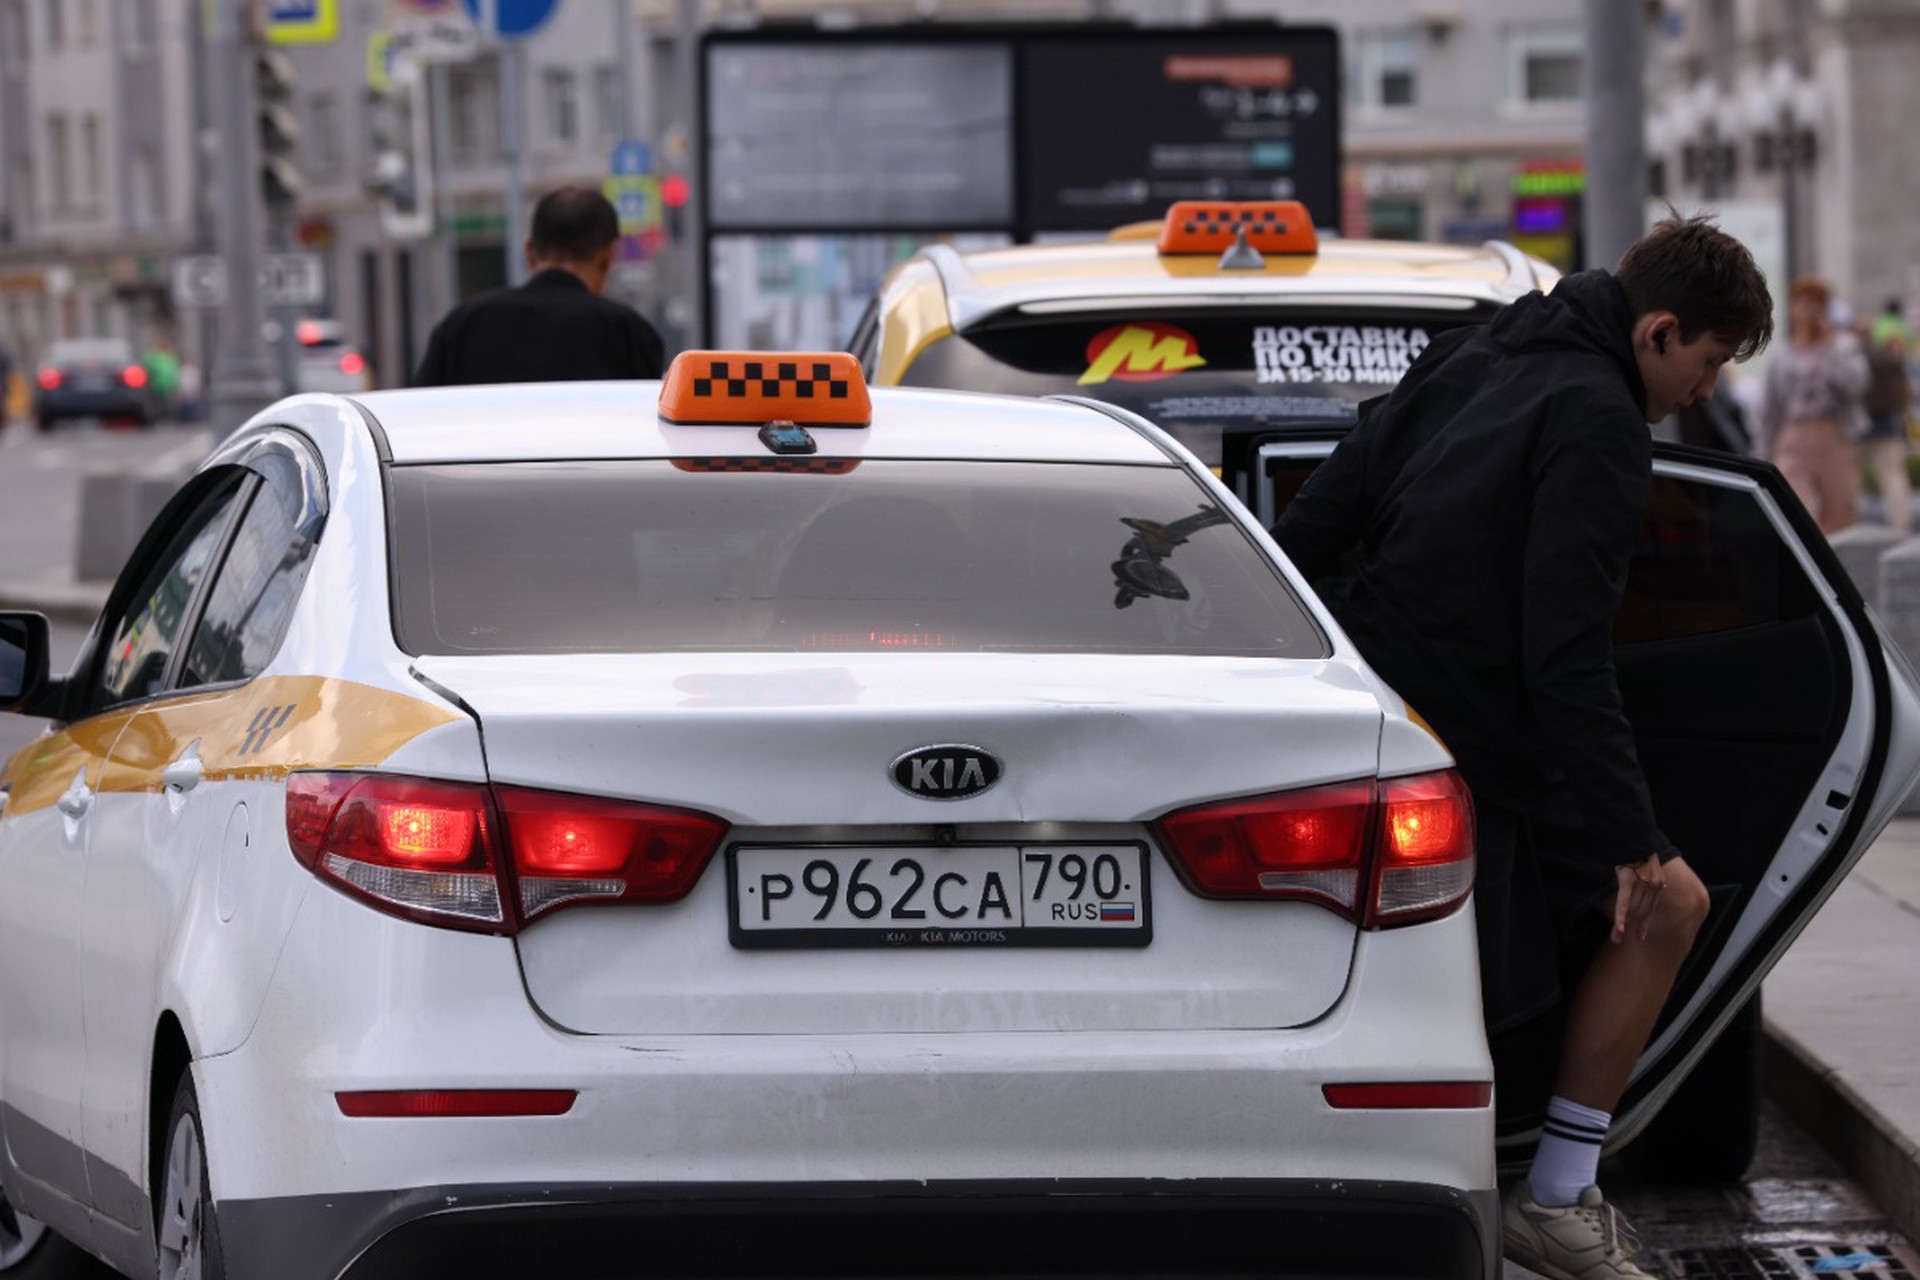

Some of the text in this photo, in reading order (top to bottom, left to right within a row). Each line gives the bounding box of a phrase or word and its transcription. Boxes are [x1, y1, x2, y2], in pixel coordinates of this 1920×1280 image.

[1252, 326, 1430, 348] ДОСТАВКА
[1255, 346, 1306, 367] ПО
[1257, 367, 1286, 383] ЗА
[911, 758, 987, 790] KIA
[1025, 853, 1122, 900] 790
[1051, 903, 1098, 920] RUS
[920, 931, 945, 943] KIA
[948, 930, 1007, 943] MOTORS
